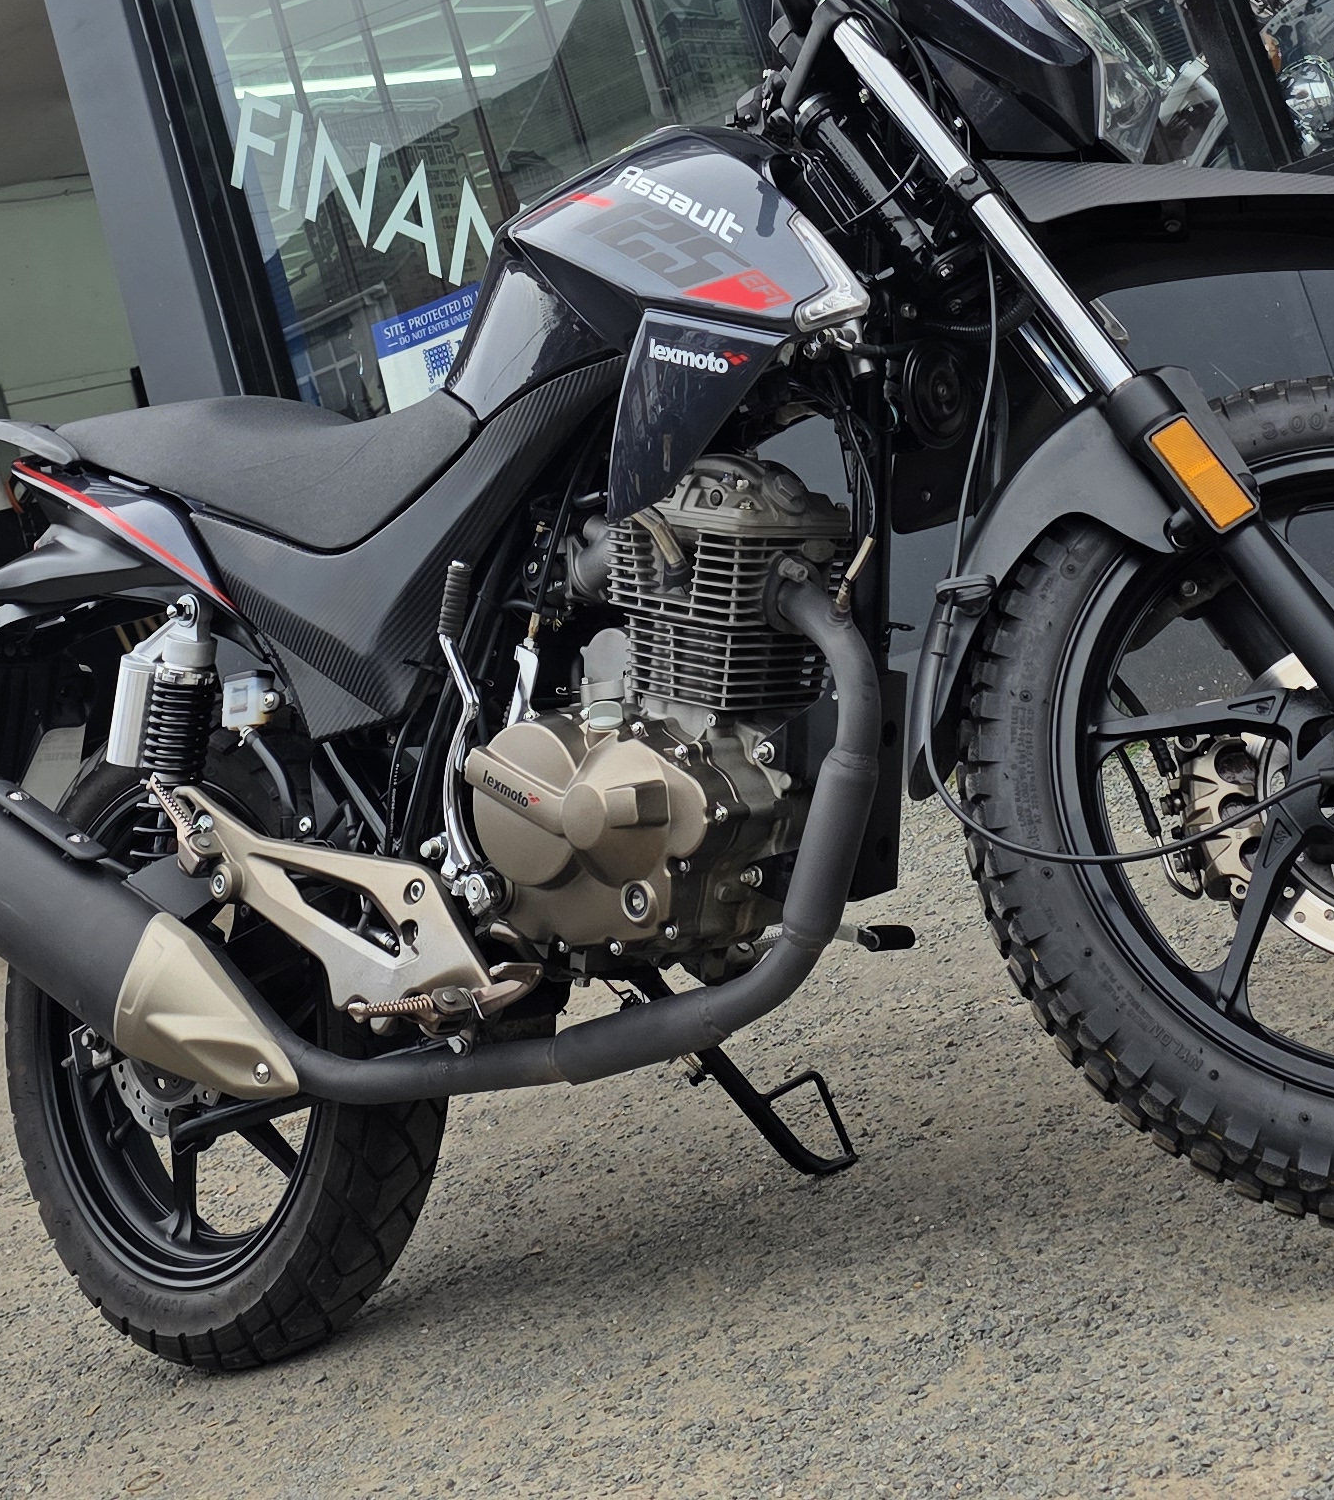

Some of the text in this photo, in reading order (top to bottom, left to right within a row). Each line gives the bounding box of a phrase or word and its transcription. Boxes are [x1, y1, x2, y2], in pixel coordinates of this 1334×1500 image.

[613, 165, 744, 244] Assault
[570, 201, 752, 289] 125
[737, 273, 787, 304] EFI
[383, 294, 474, 340] SITE PROTECTED BY
[398, 334, 411, 346] DO
[412, 329, 426, 341] NOT
[428, 320, 450, 335] ENTER
[648, 337, 729, 374] lexmoto
[481, 769, 529, 809] lexmoto
[1148, 1021, 1205, 1072] NYLON
